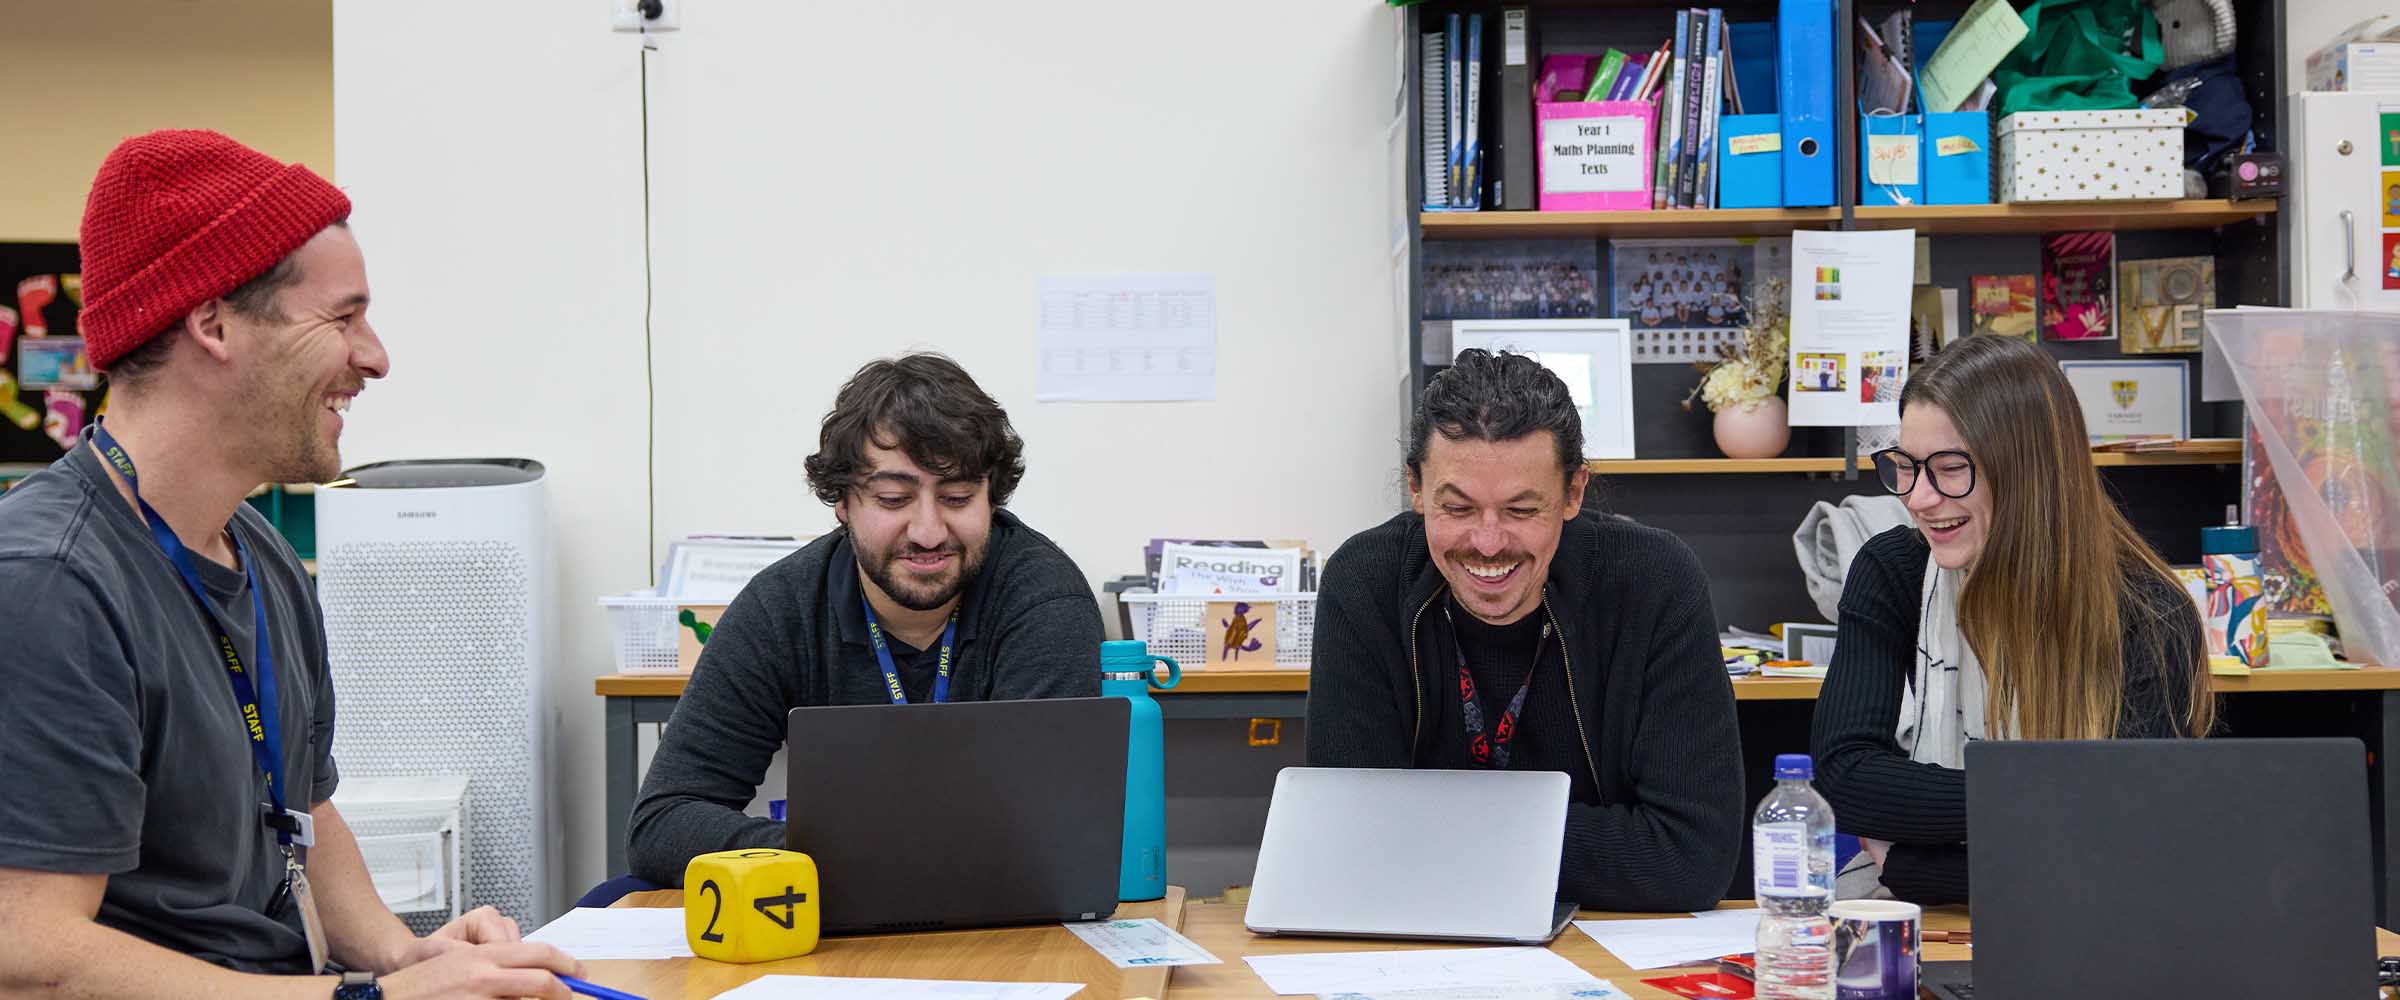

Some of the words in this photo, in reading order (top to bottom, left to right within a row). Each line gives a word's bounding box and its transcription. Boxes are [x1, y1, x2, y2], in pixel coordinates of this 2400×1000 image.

[1577, 124, 1601, 137] Year
[1605, 124, 1611, 137] 1
[1553, 143, 1583, 157] Maths
[1586, 143, 1635, 157] Planning
[1581, 163, 1609, 175] Texts
[106, 447, 137, 479] STAFF
[396, 511, 438, 519] SAMSUNG
[1176, 556, 1285, 578] Reading
[219, 635, 244, 674] STAFF
[939, 646, 950, 677] STAFF
[886, 671, 903, 701] STAFF
[243, 703, 265, 742] STAFF
[699, 879, 724, 944] 2
[753, 885, 807, 930] 4
